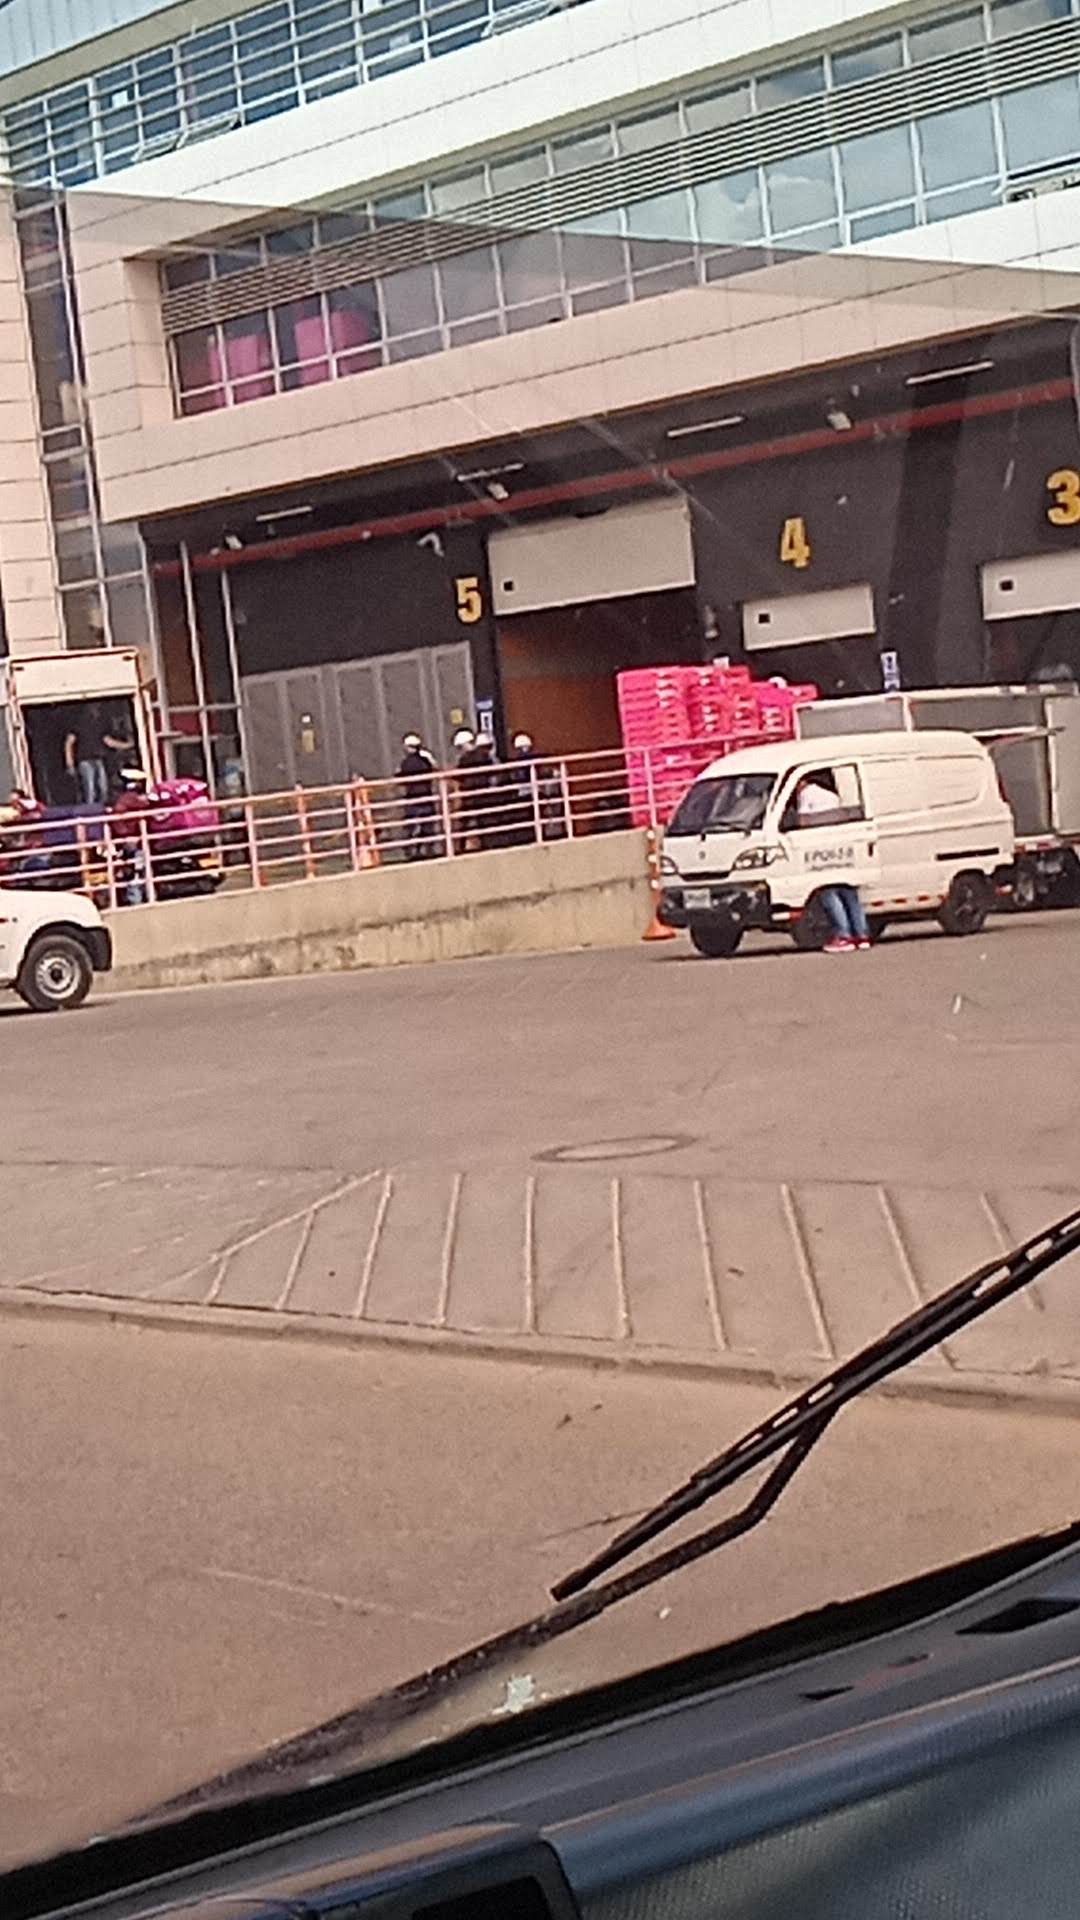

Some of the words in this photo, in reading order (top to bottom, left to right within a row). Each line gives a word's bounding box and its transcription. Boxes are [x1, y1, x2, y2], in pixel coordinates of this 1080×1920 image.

[1047, 469, 1080, 524] 3
[781, 517, 810, 568] 4
[455, 576, 482, 623] 5
